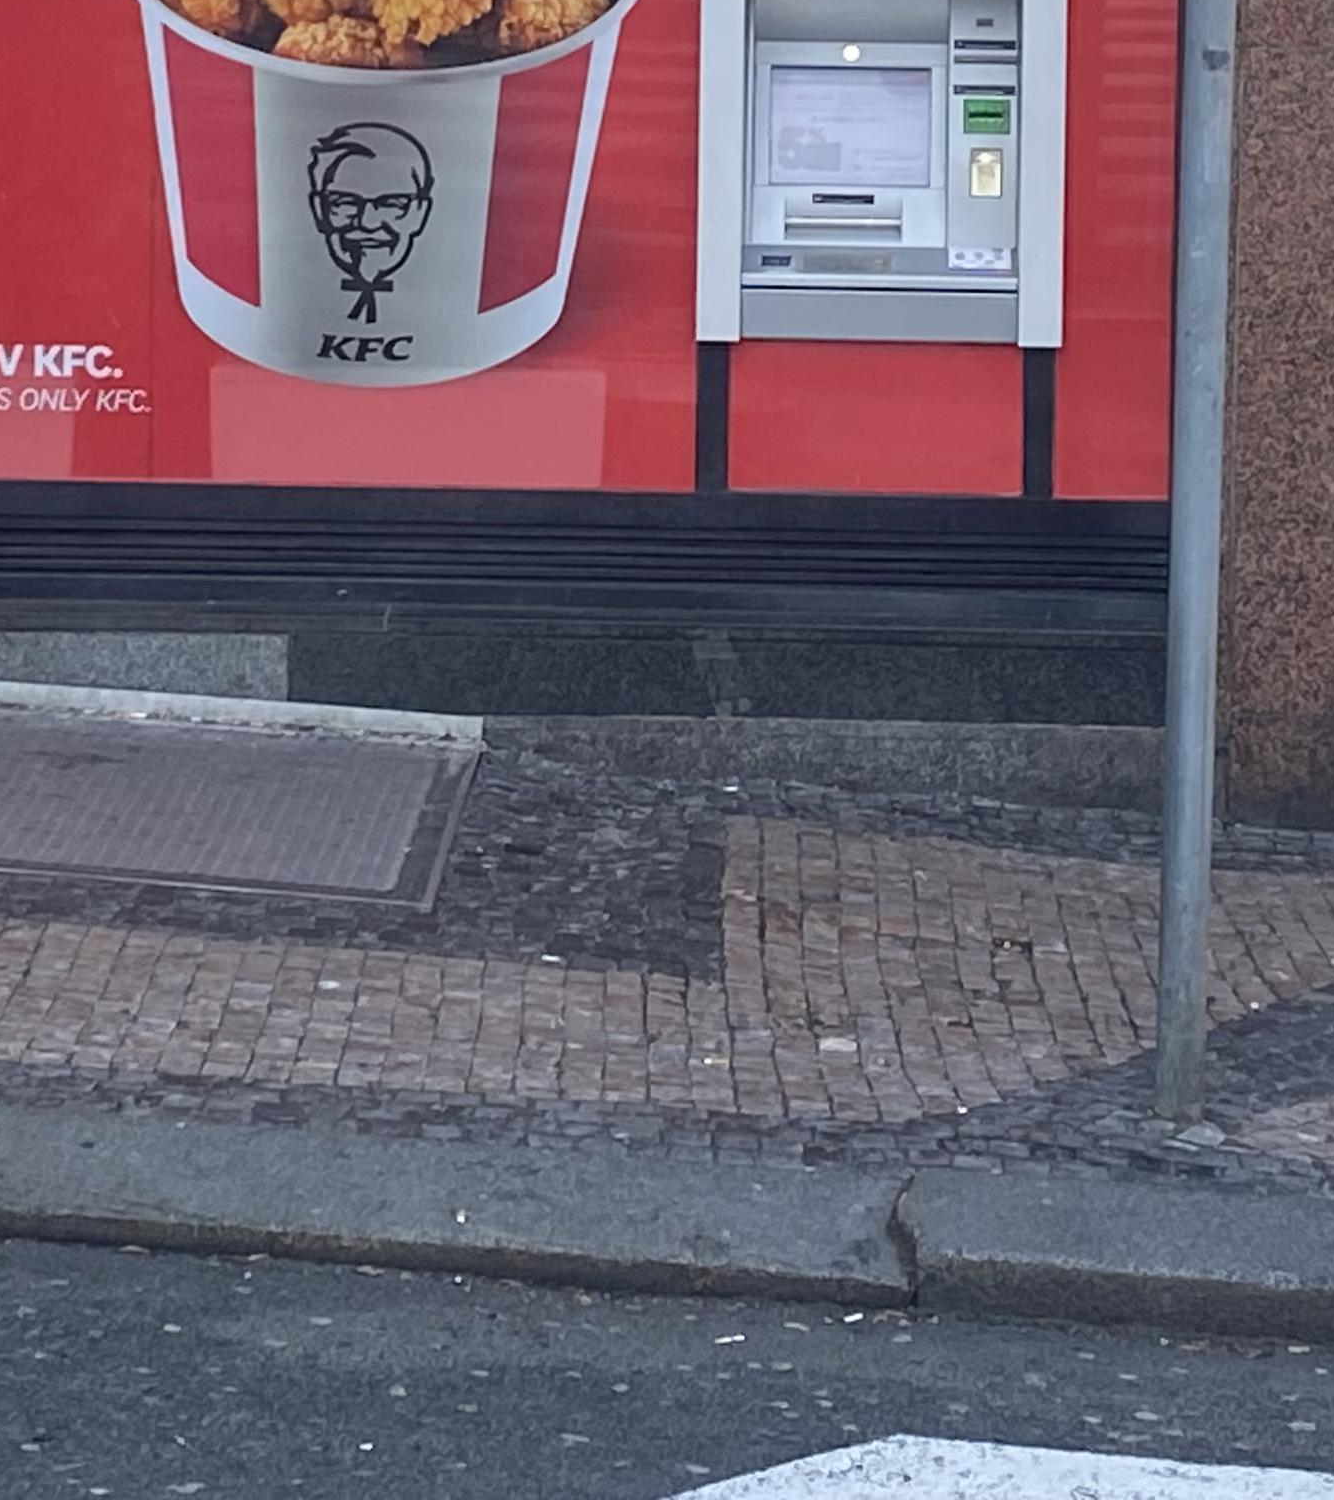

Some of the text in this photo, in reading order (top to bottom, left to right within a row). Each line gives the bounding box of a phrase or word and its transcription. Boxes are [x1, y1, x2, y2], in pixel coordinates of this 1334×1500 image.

[33, 345, 124, 379] KFC.
[315, 333, 414, 363] KFC
[19, 388, 90, 412] ONLY
[96, 389, 153, 413] KFC.
